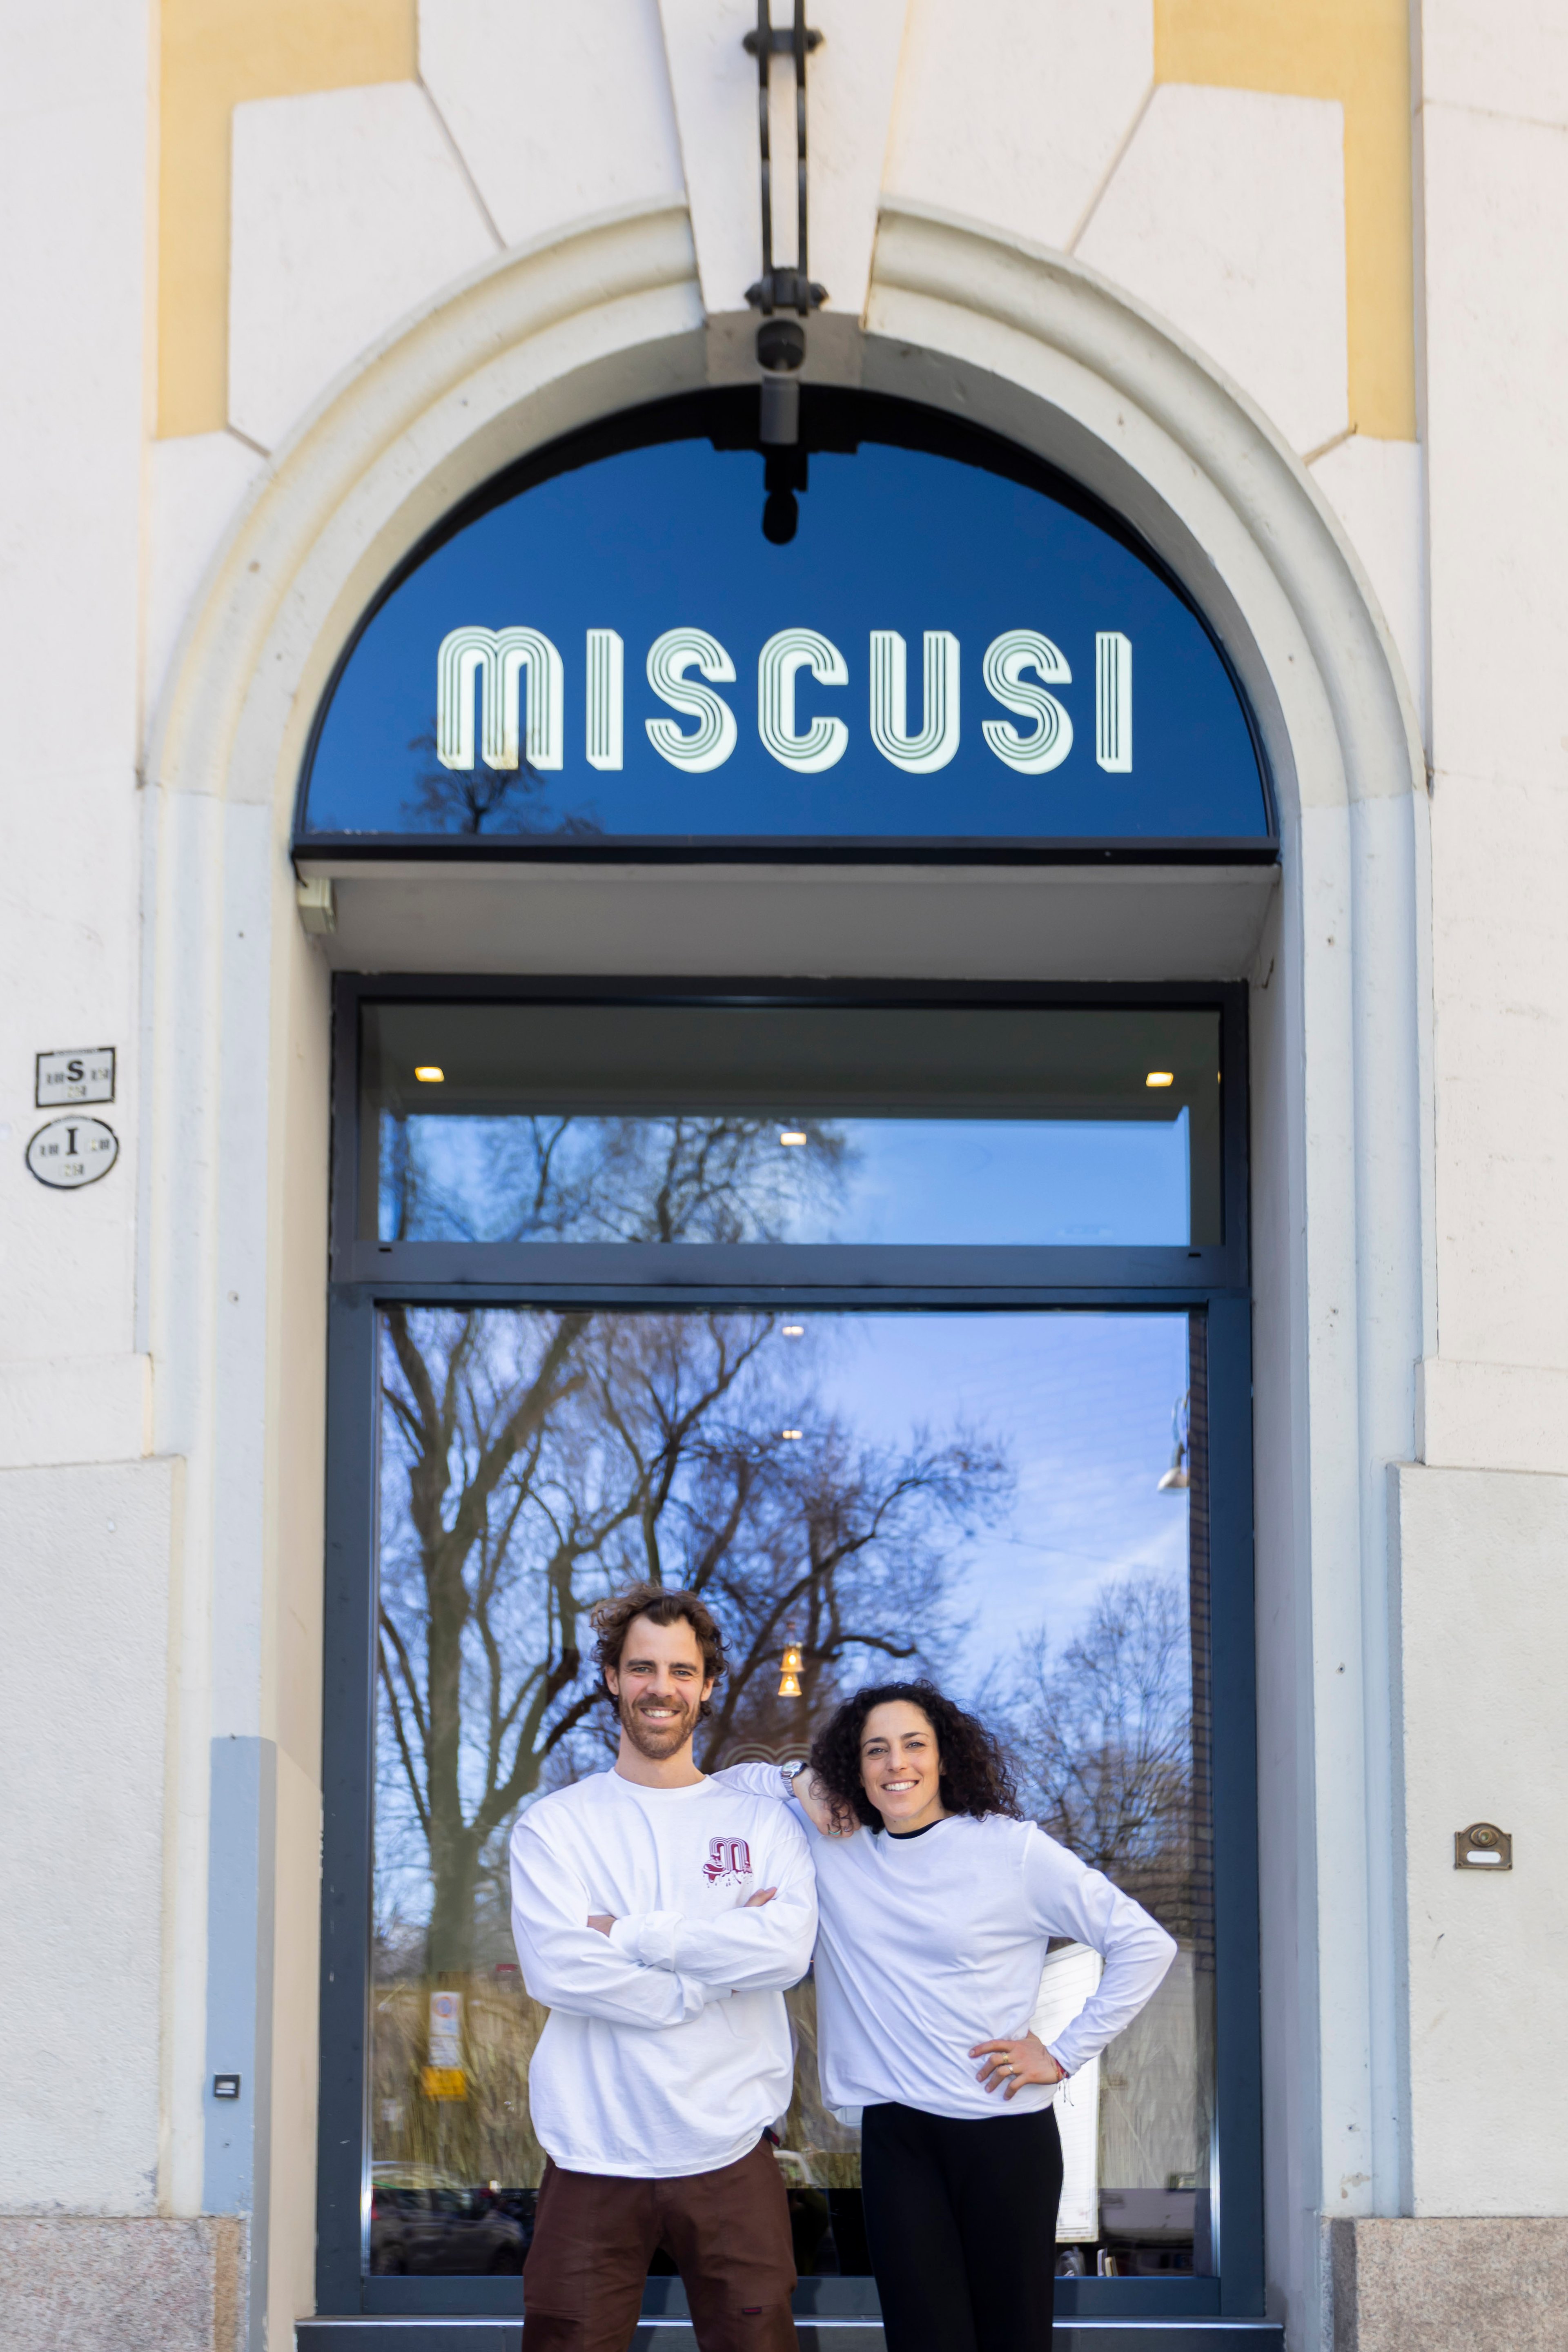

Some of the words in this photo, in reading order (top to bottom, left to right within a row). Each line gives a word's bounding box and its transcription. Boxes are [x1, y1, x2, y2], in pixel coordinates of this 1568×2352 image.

[436, 626, 1133, 775] MISCUSI
[67, 1060, 84, 1082] S
[66, 1127, 78, 1156] I
